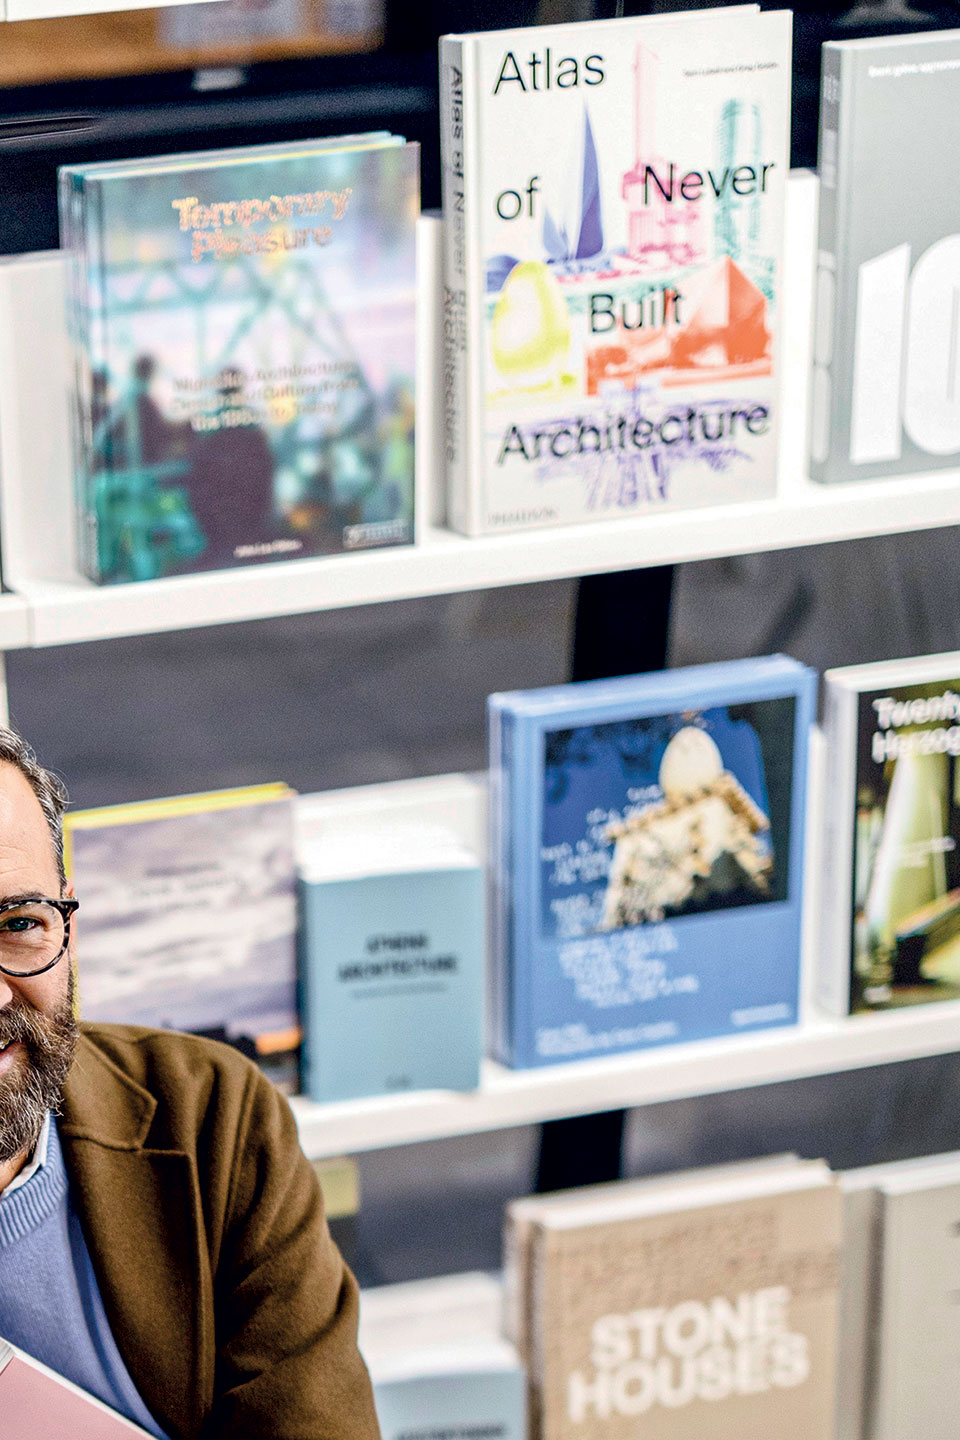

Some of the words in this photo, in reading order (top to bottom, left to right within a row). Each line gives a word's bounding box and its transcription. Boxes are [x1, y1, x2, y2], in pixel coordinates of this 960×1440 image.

[450, 66, 464, 139] Atlas
[493, 49, 607, 95] Atlas
[171, 187, 353, 231] Temporary
[496, 176, 540, 221] of
[643, 160, 775, 206] Never
[191, 225, 332, 263] Pleasure
[589, 288, 687, 333] Built
[497, 403, 771, 467] Architecture
[590, 1285, 791, 1370] STONE
[565, 1332, 810, 1424] HOUSES
